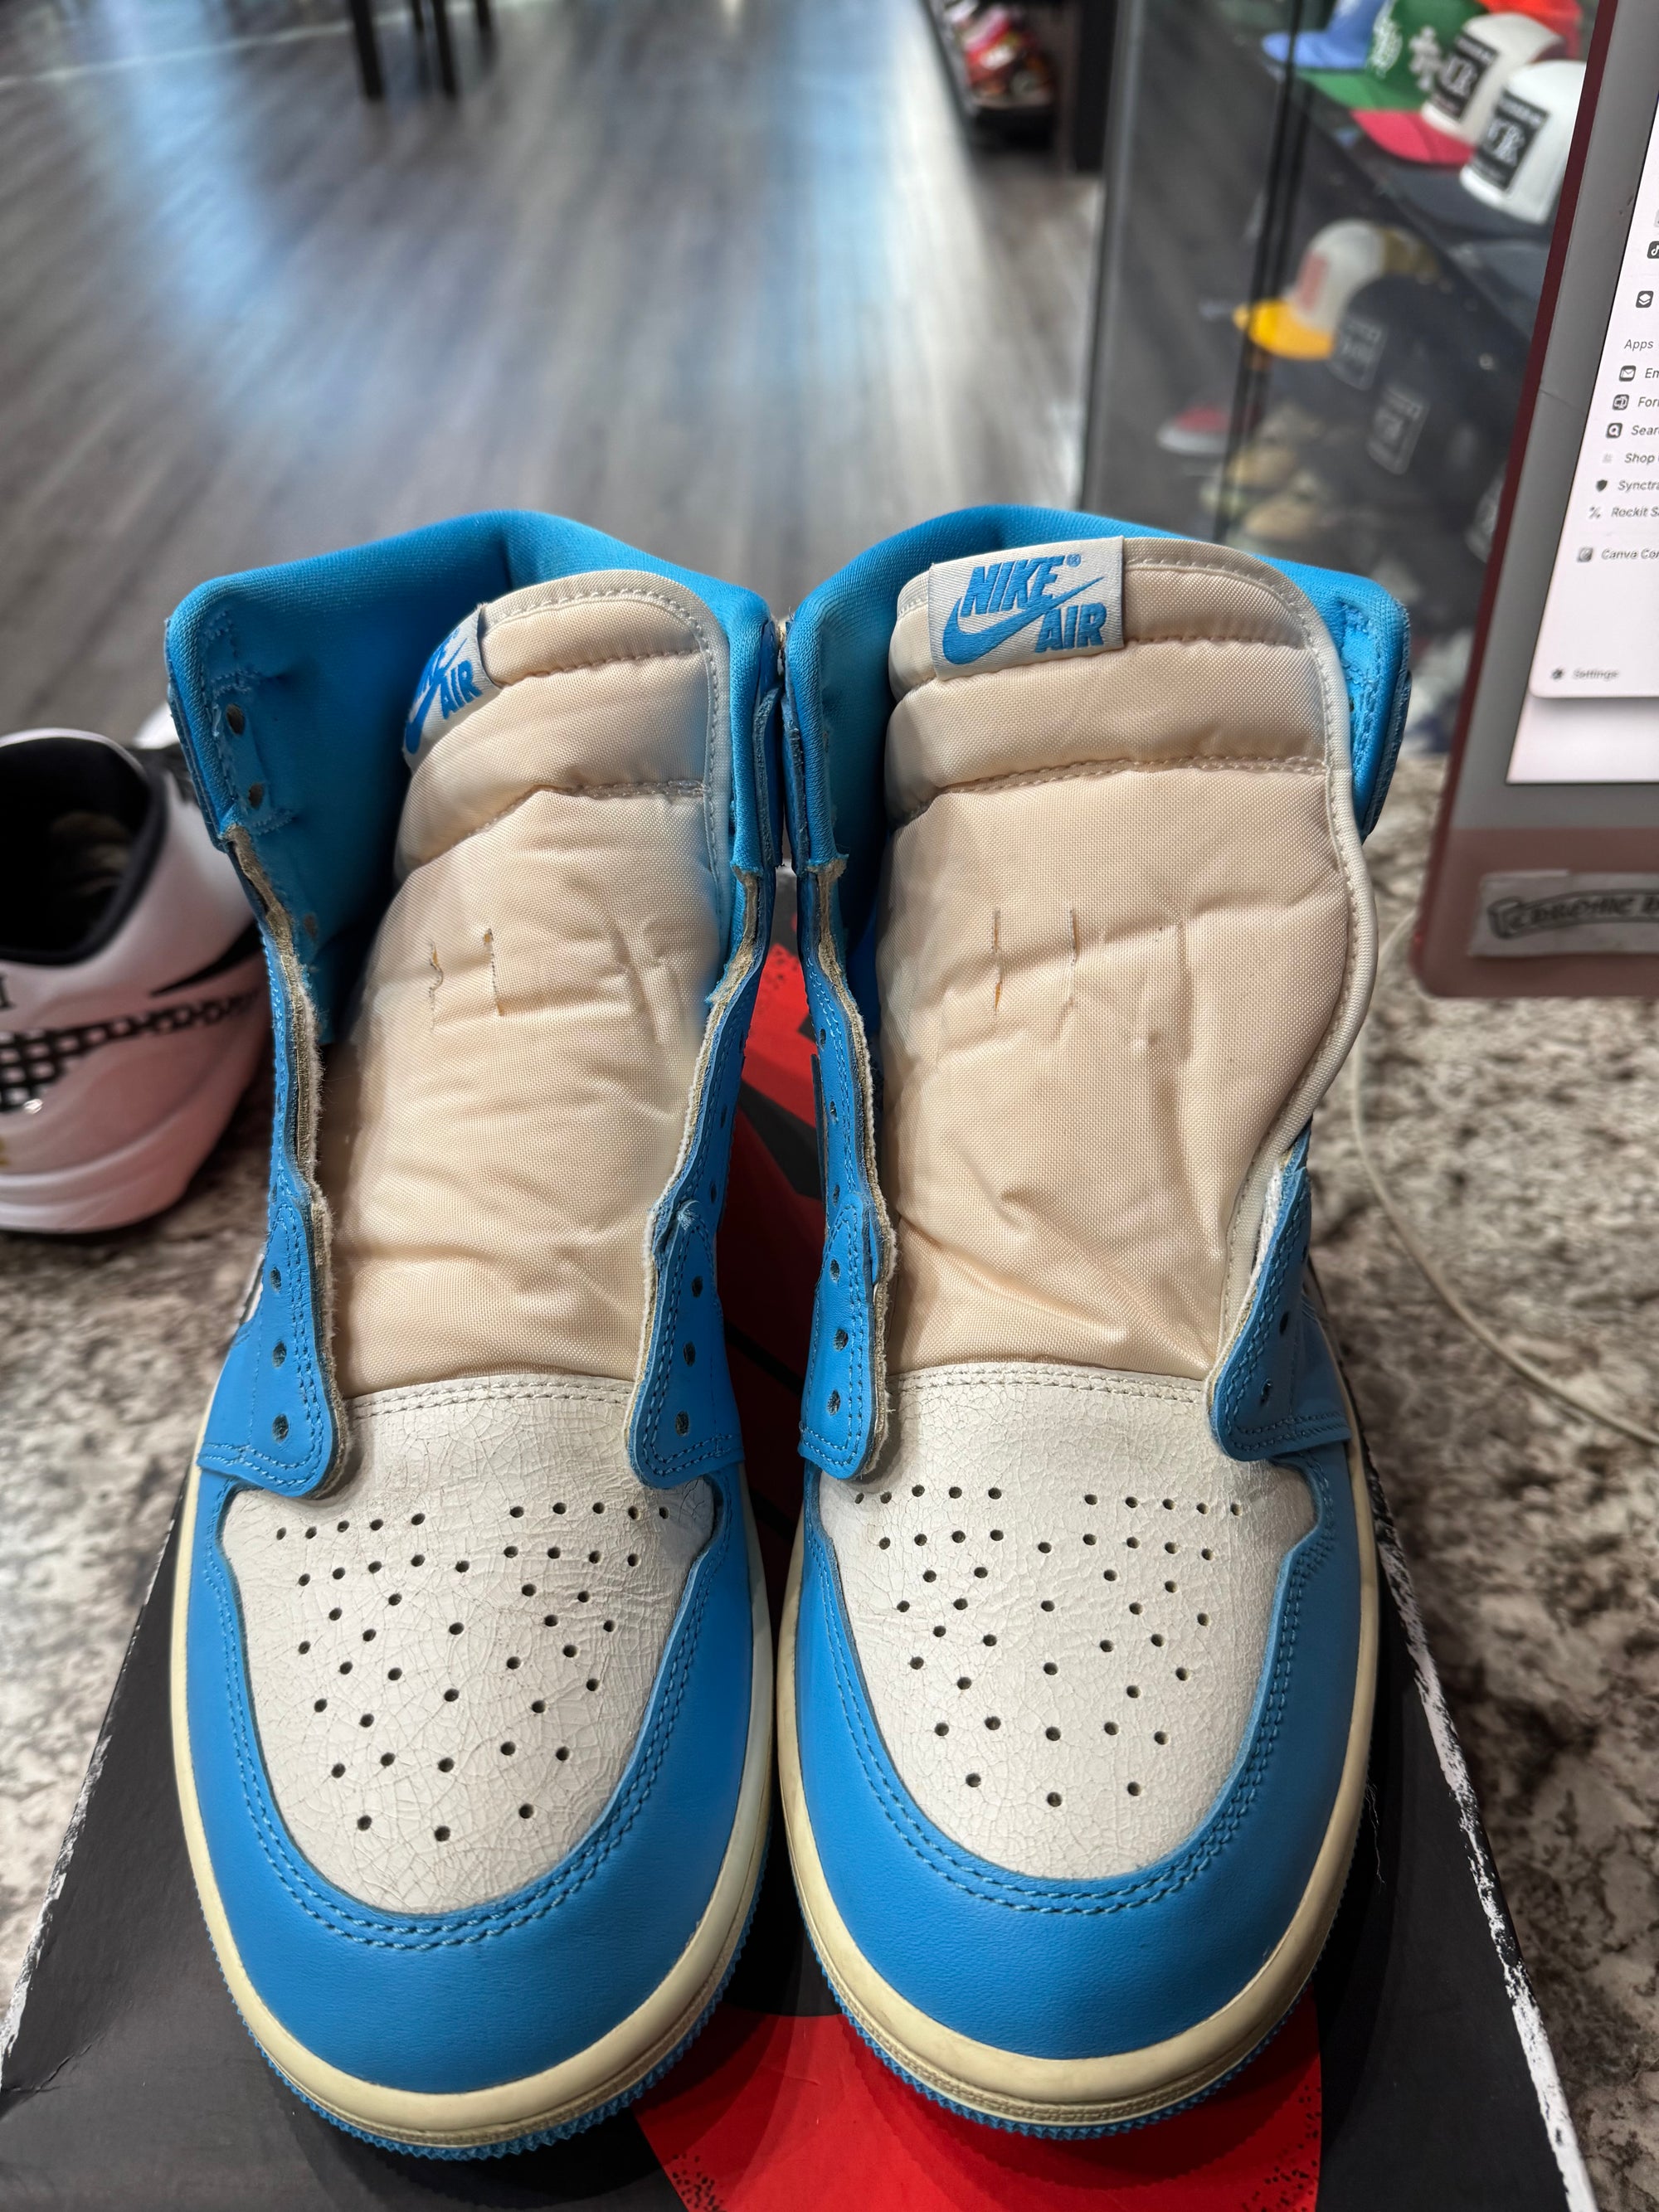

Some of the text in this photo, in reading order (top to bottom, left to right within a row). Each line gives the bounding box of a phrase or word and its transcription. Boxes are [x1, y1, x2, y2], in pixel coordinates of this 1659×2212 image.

[1624, 338, 1654, 352] Apps
[1624, 452, 1656, 465] Shop
[1611, 506, 1648, 518] Rockit
[1034, 602, 1107, 654] AIR
[440, 659, 483, 720] AIR
